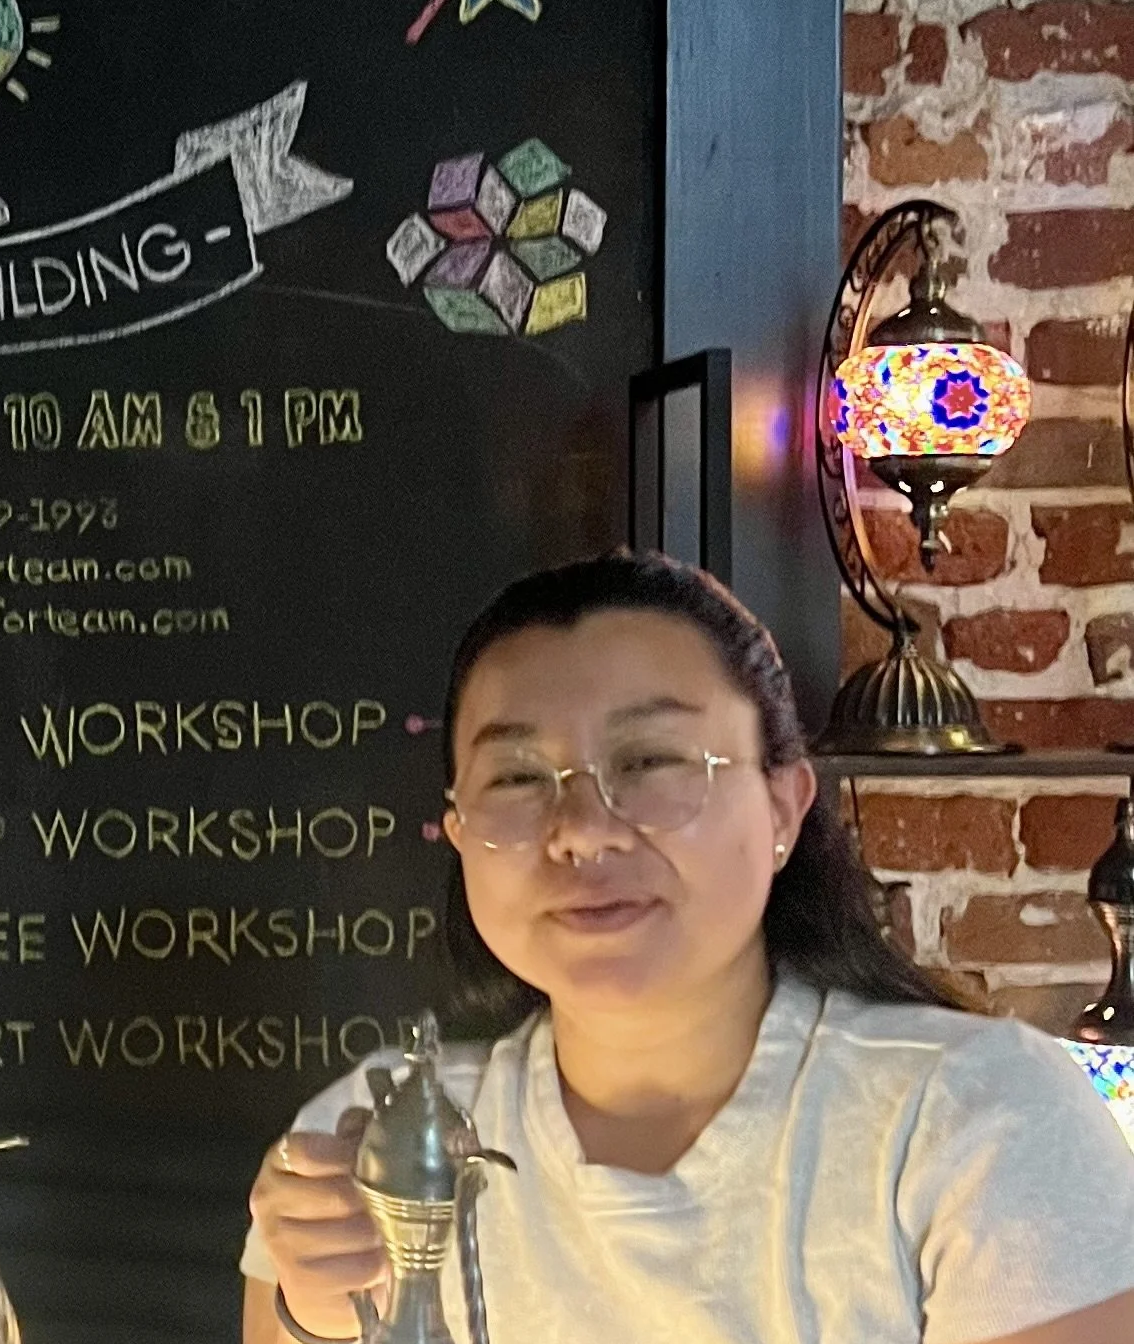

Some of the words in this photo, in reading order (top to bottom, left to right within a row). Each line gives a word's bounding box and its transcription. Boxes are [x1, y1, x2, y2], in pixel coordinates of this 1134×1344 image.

[3, 392, 61, 451] 10
[77, 389, 163, 449] AM
[240, 389, 263, 448] 1
[284, 387, 363, 448] PM
[20, 699, 386, 768] WORKSHOP
[32, 805, 396, 861] WORKSHOP
[71, 905, 436, 967] WORKSHOP
